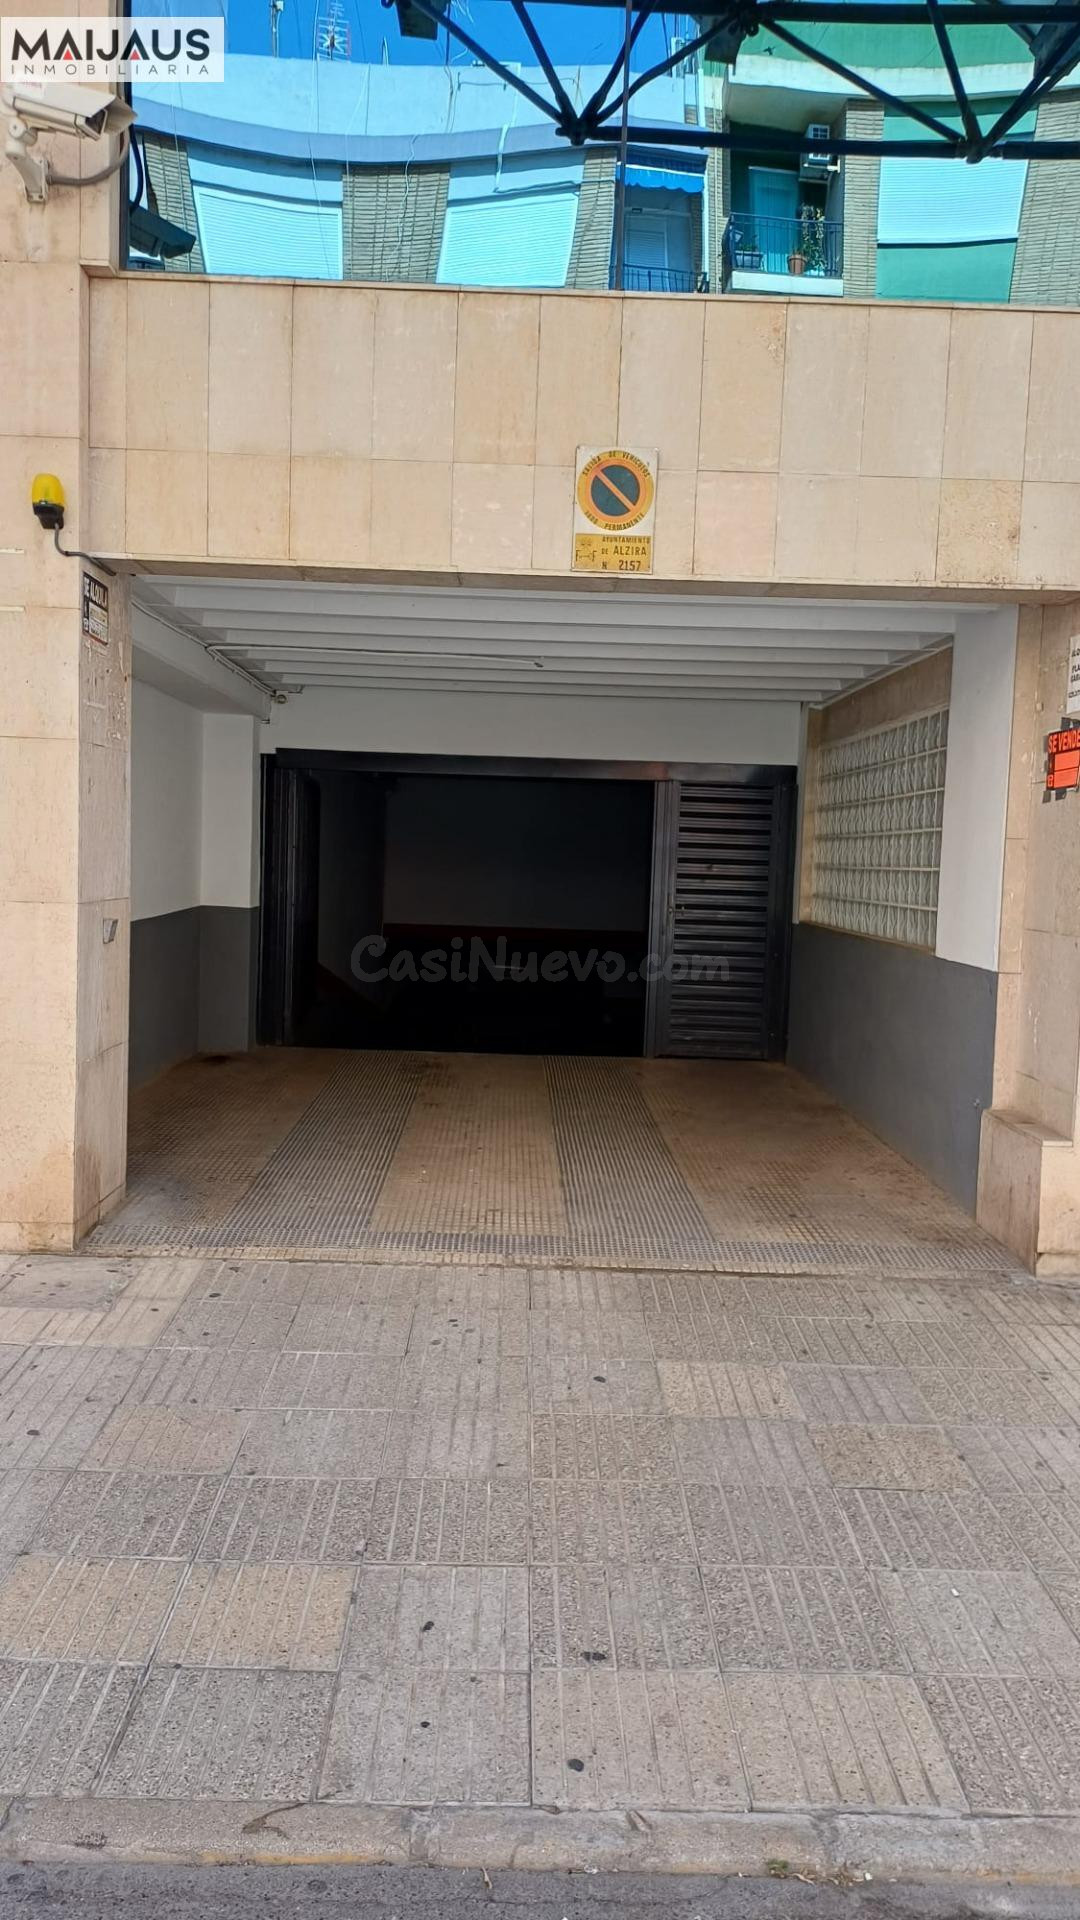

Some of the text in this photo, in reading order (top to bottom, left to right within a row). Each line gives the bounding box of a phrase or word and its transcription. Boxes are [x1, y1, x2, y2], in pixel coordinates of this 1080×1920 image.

[582, 455, 601, 476] SALIDA
[608, 450, 617, 458] DE
[604, 512, 645, 531] PERMANENTE
[602, 536, 650, 544] AYUNTAMIENTO
[613, 545, 647, 556] ALZIRA
[619, 560, 641, 571] 2157
[1048, 734, 1058, 753] SE
